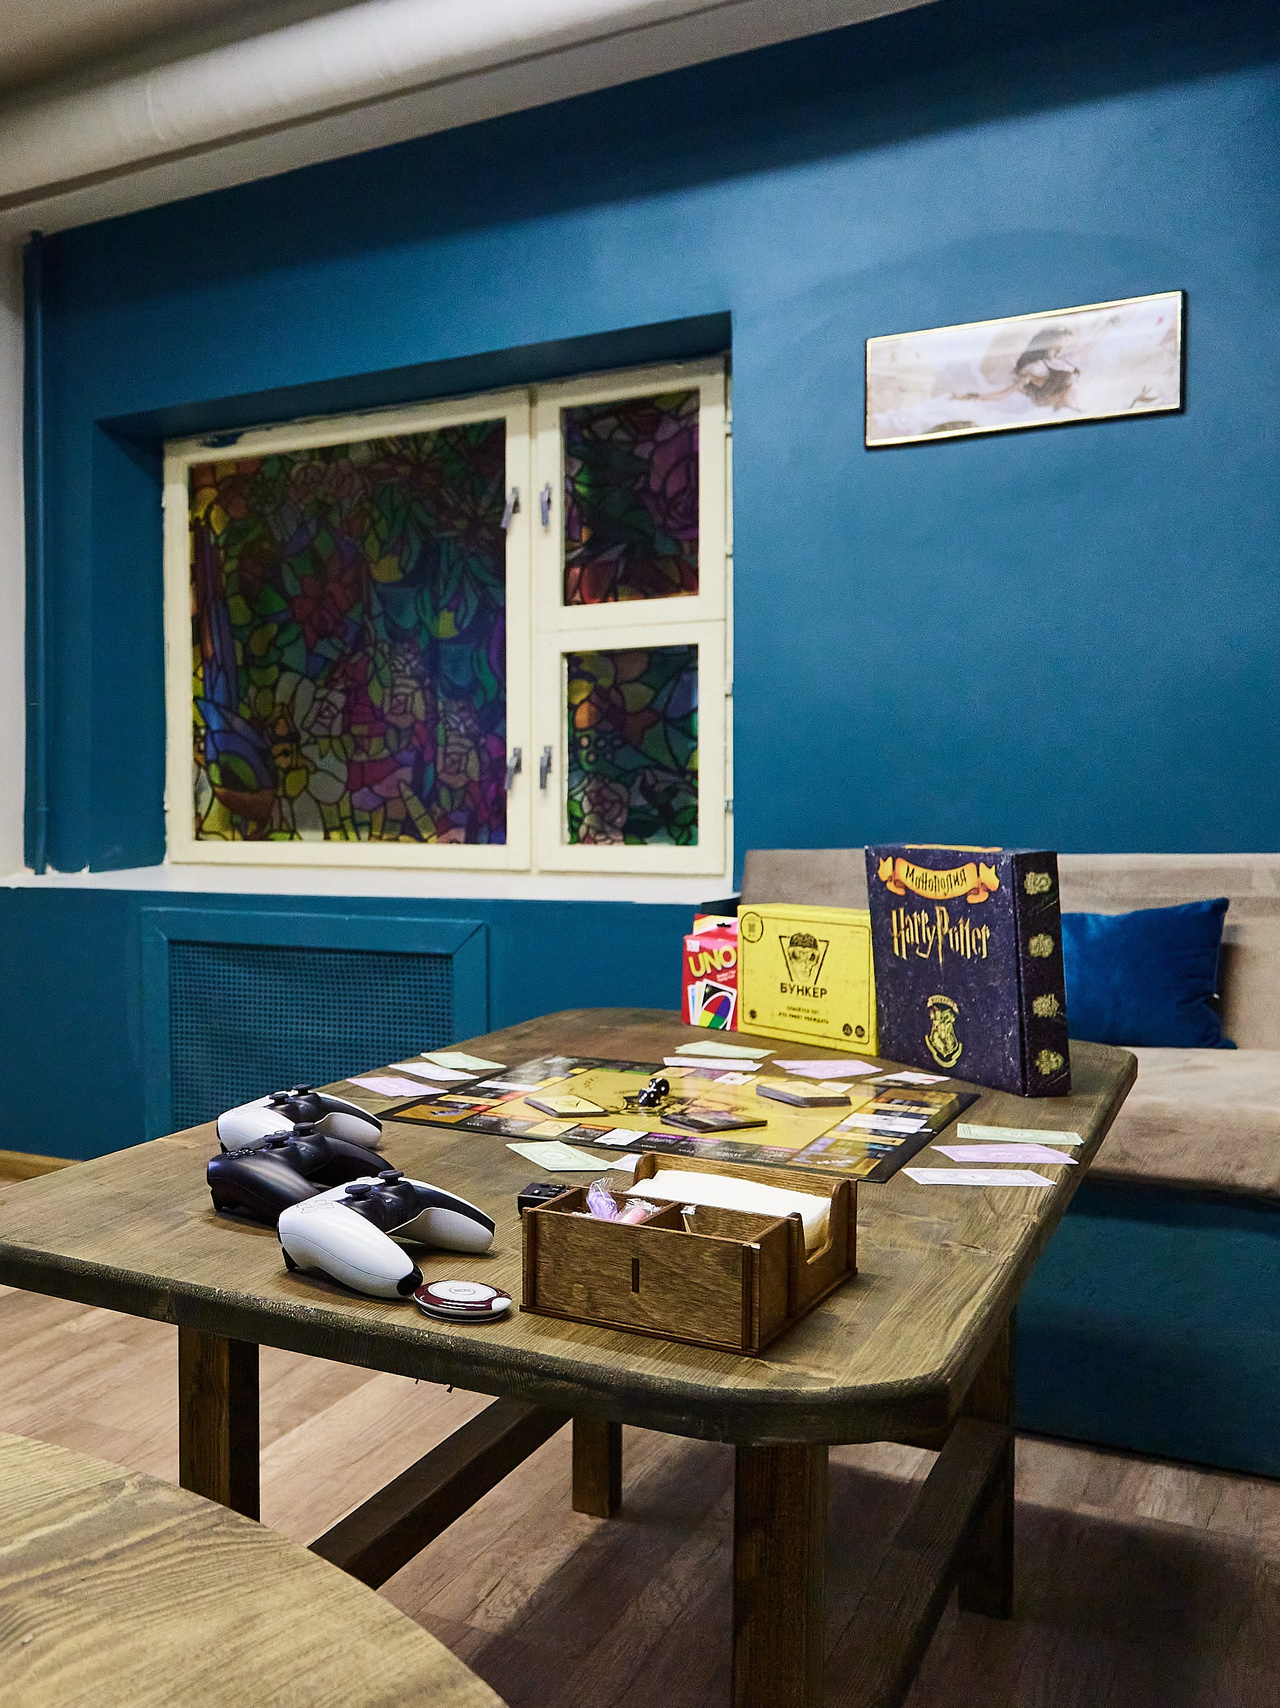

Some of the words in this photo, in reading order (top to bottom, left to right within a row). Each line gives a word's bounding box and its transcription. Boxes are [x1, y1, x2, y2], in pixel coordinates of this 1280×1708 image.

[891, 907, 936, 960] Harry
[934, 905, 991, 965] Potter
[688, 944, 737, 978] UNO
[780, 982, 828, 999] БУНКЕР
